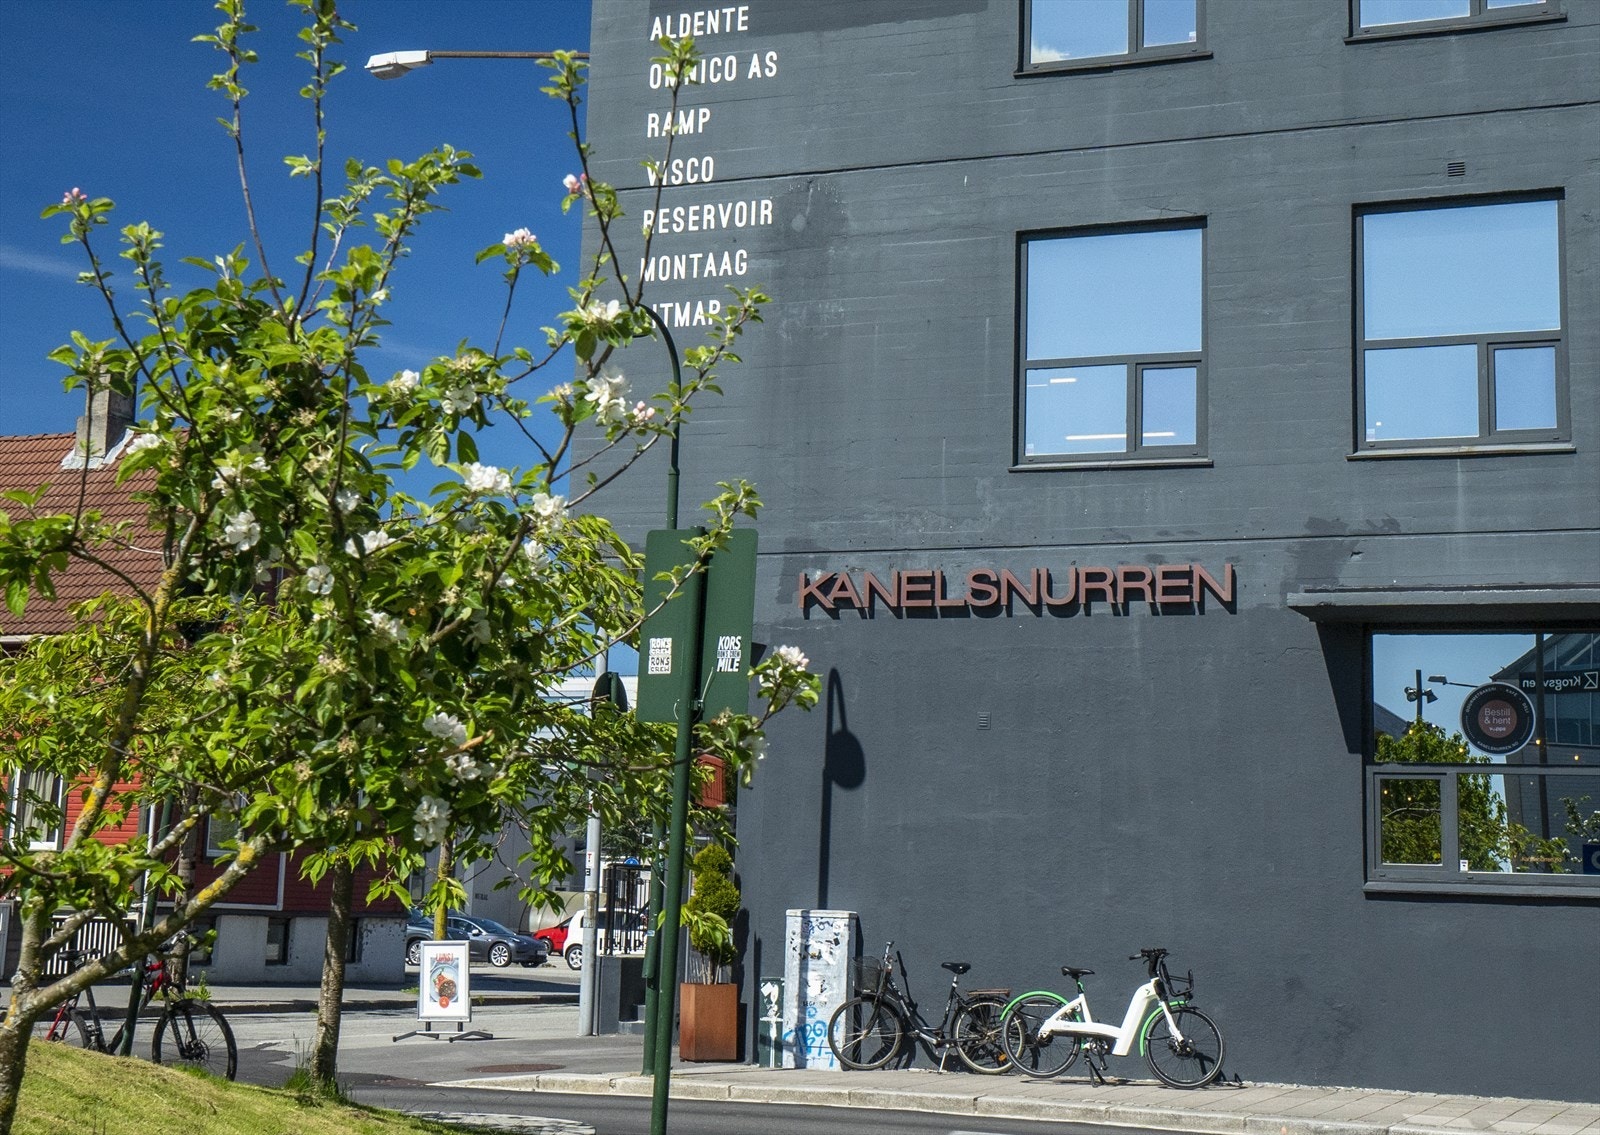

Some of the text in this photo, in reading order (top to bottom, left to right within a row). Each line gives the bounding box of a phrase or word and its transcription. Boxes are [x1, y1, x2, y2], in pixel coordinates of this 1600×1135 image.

[650, 6, 749, 41] ALDENTE
[747, 51, 778, 79] AS
[647, 108, 711, 138] RAMP
[646, 156, 714, 187] VISCO
[643, 199, 773, 234] RESERVOIR
[640, 249, 748, 282] MONTAAG
[641, 300, 721, 329] ITMAP
[798, 563, 1233, 609] KANELSNURREN
[718, 636, 741, 650] KORS
[717, 658, 740, 672] MILE
[1484, 708, 1511, 716] Bestill
